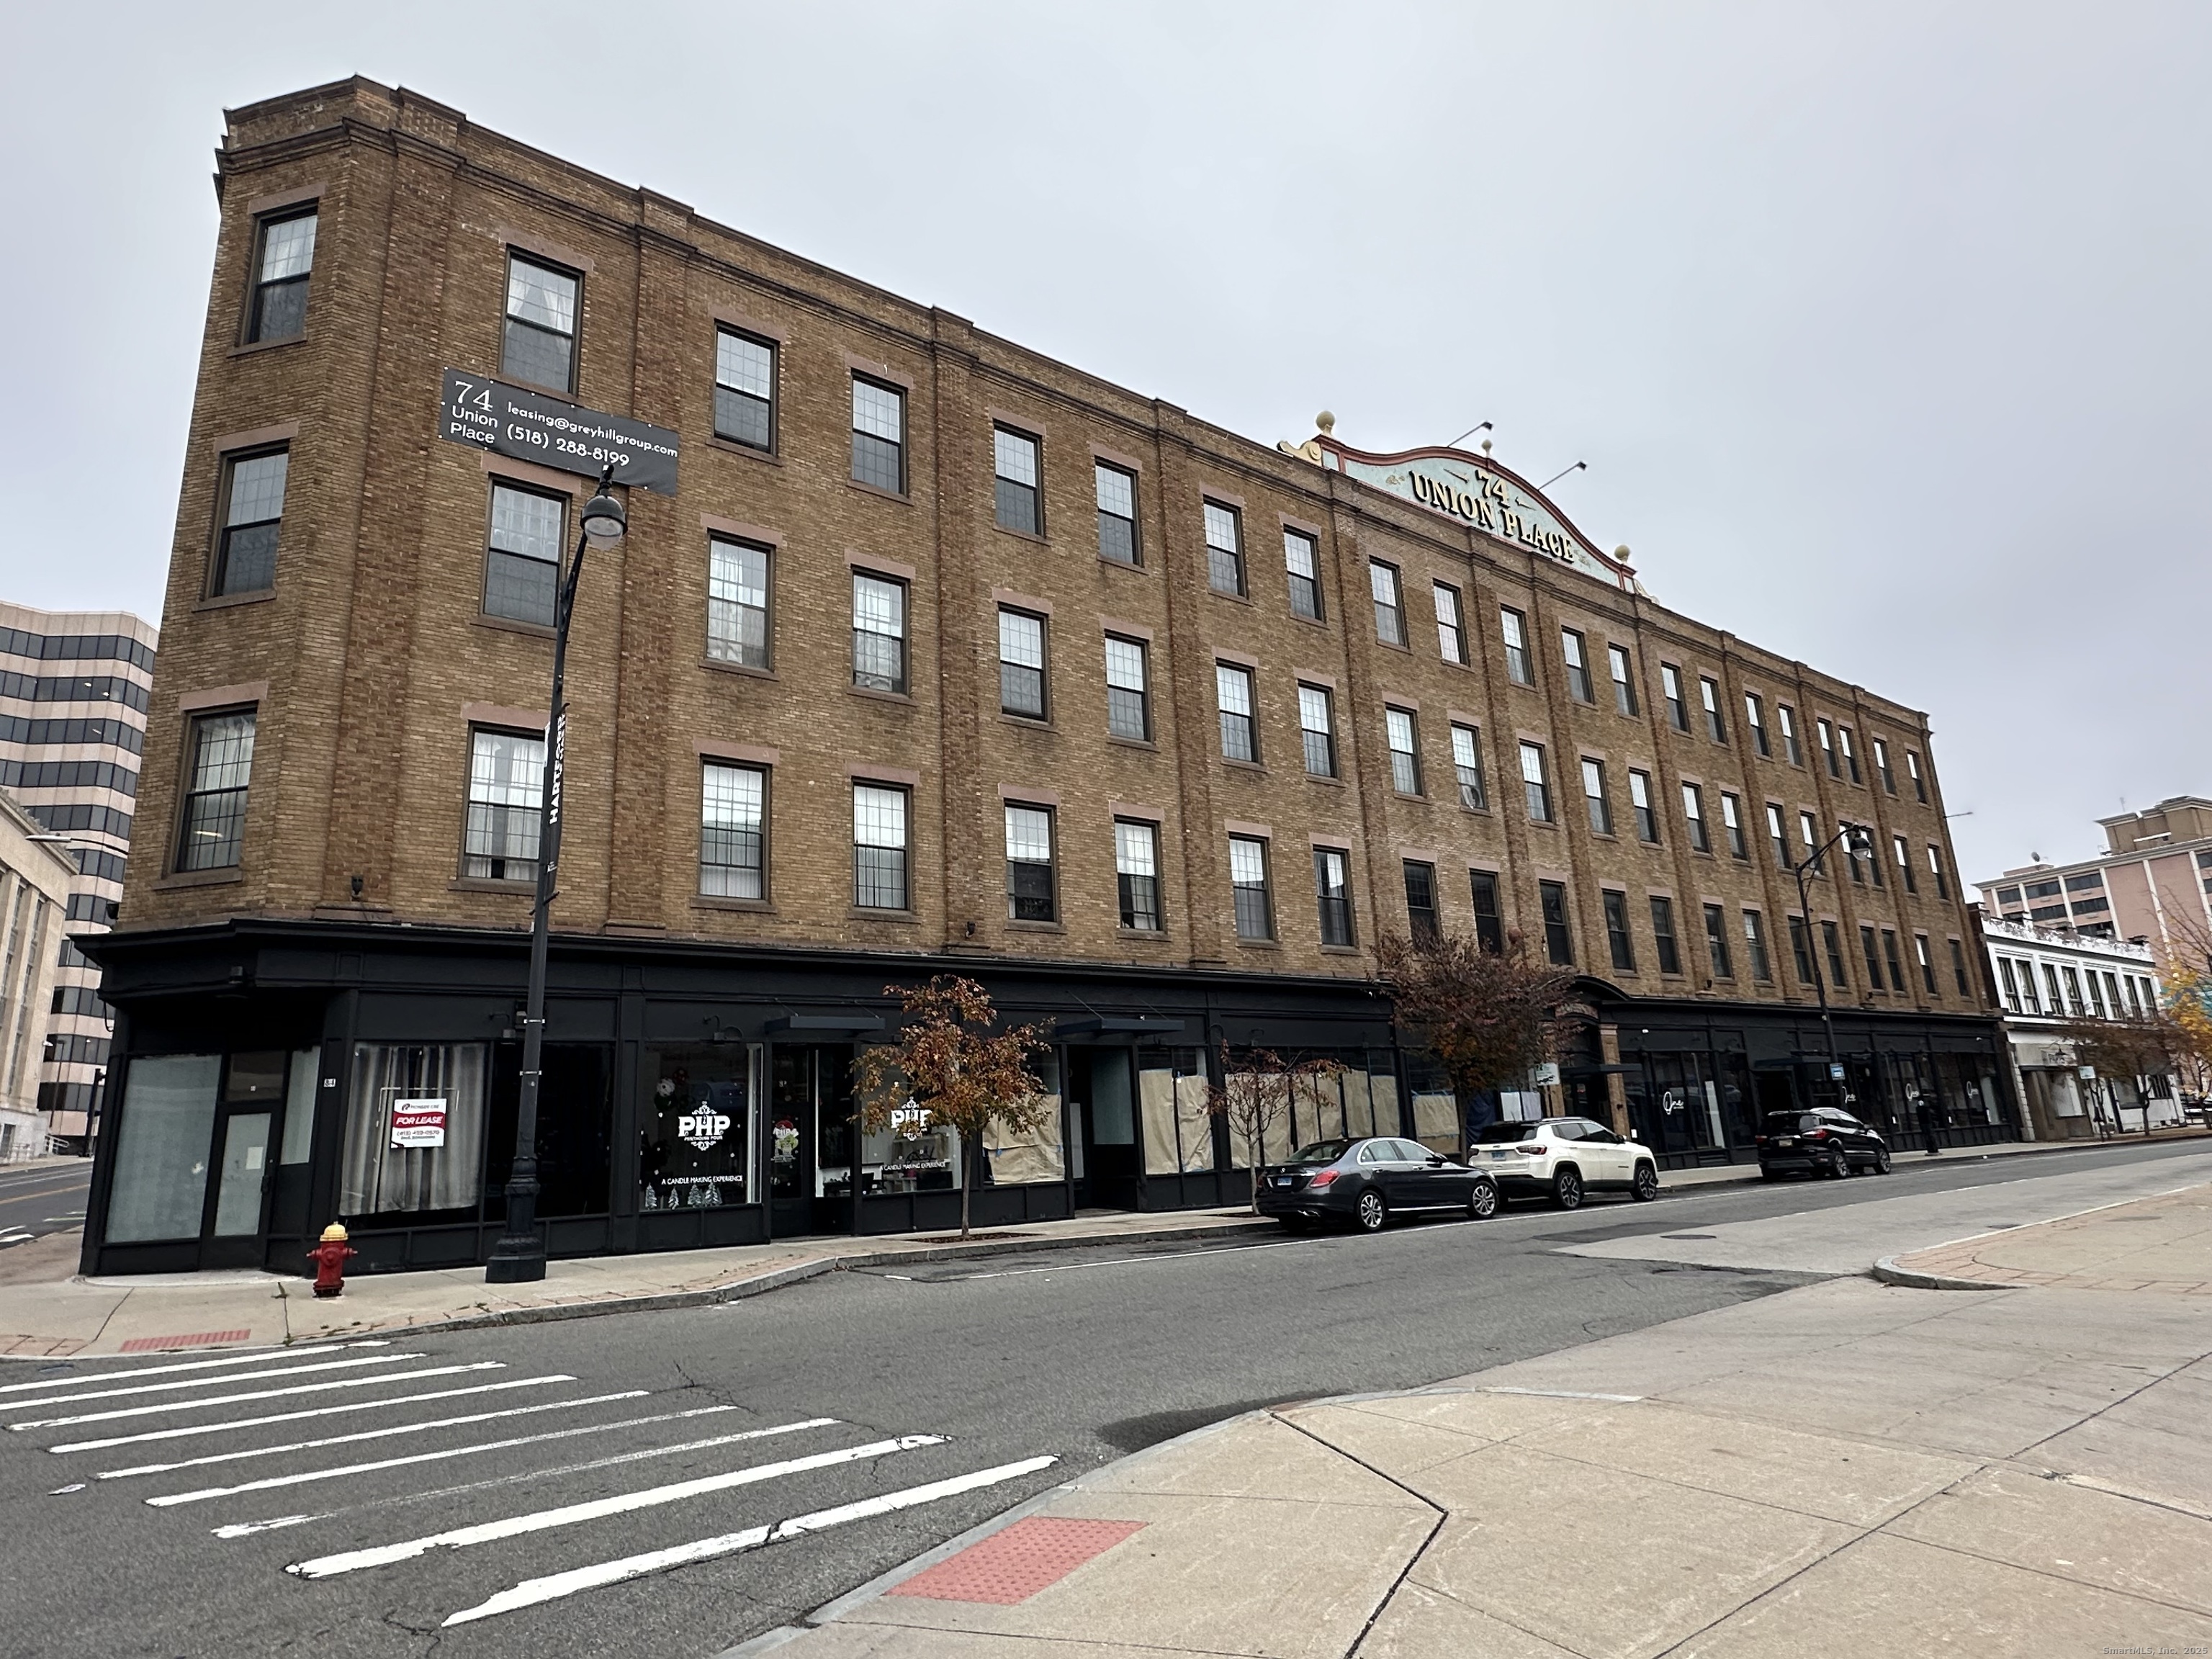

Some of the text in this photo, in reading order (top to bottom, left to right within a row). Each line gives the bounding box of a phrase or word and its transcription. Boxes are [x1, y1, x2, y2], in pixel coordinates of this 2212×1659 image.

[454, 380, 494, 413] 74
[450, 421, 495, 444] Place
[451, 405, 499, 429] Union
[507, 401, 678, 458] leasing@greyhillgroup.com
[506, 423, 631, 467] (518) 288-8199
[1475, 470, 1510, 508] 74
[1408, 470, 1575, 564] UNION PLACE
[415, 1115, 444, 1124] LEASE
[678, 1115, 731, 1137] PHP
